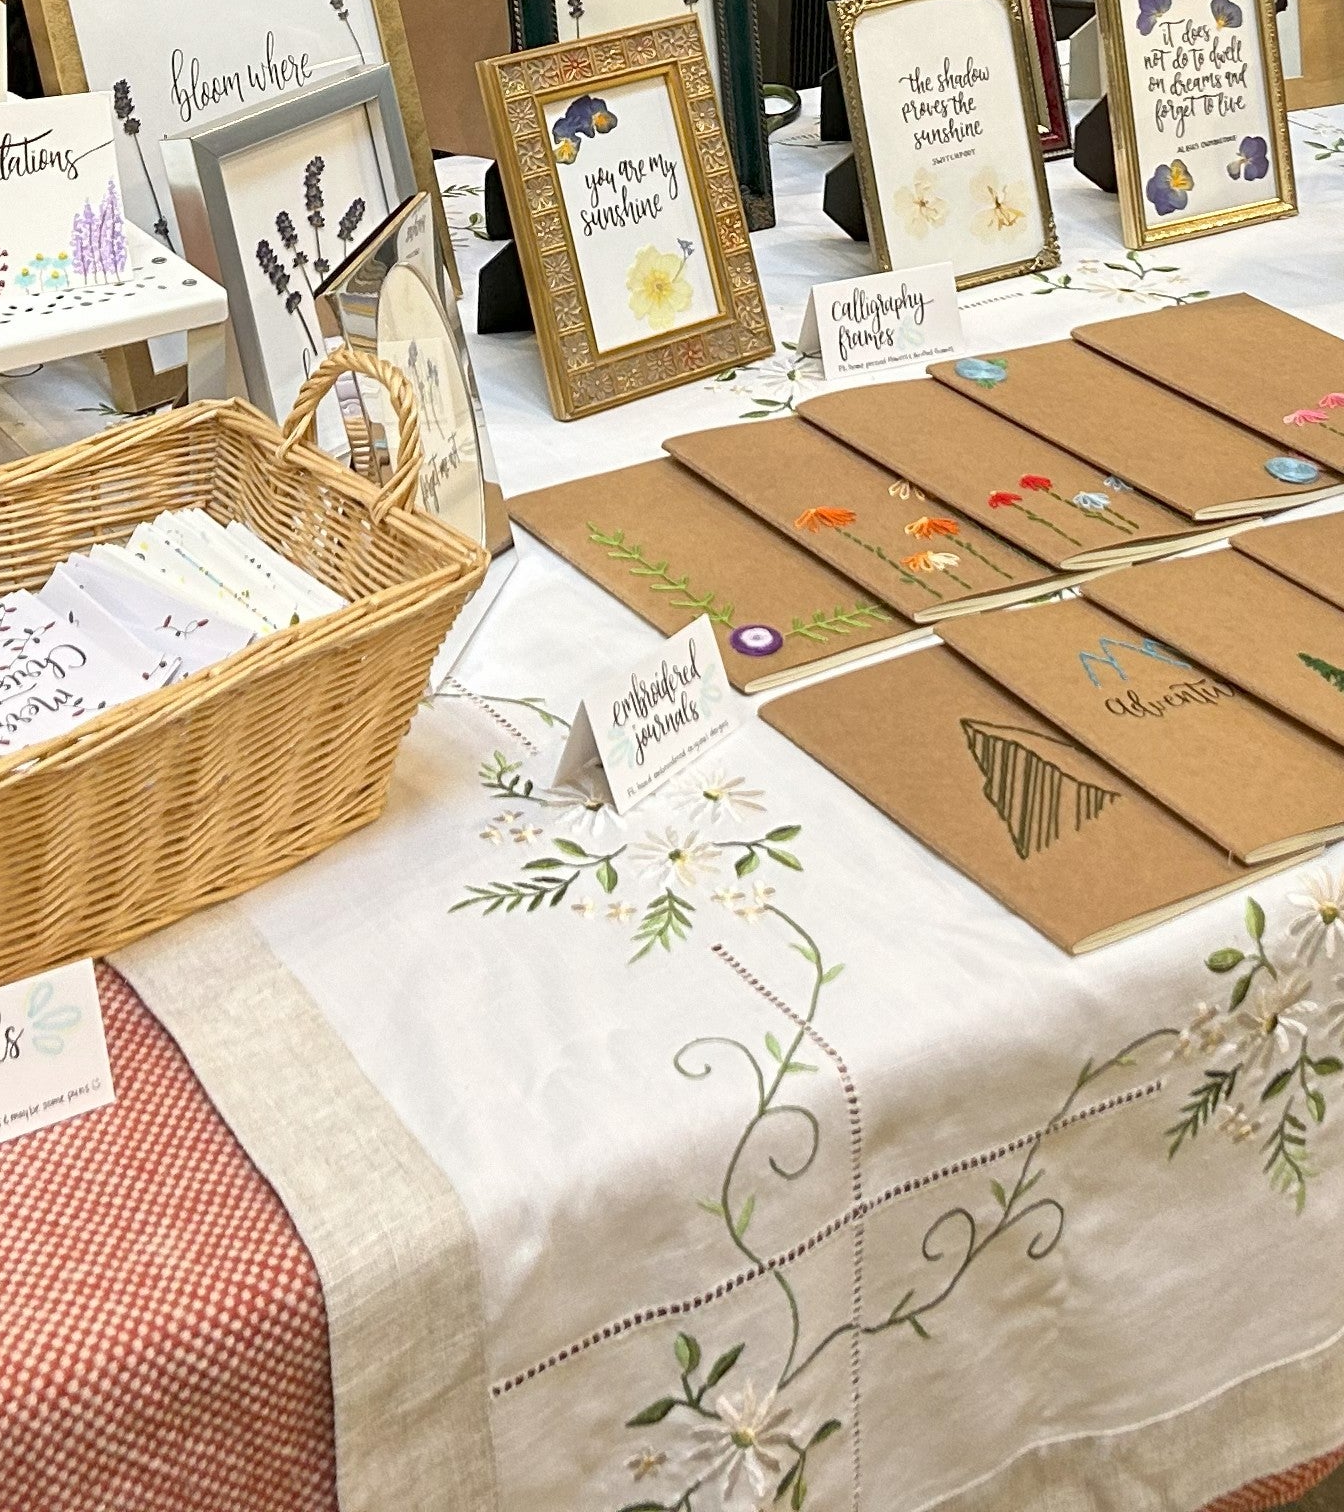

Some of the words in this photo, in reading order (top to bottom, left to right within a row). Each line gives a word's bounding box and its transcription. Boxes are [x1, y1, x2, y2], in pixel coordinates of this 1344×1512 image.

[1159, 19, 1185, 48] it
[1182, 18, 1211, 46] does
[1144, 48, 1172, 71] not
[1172, 46, 1188, 69] do
[1187, 48, 1204, 71] to
[1209, 35, 1243, 69] dwell
[170, 48, 245, 122] bloom
[247, 30, 313, 91] where
[898, 66, 934, 94] the
[937, 56, 990, 93] shadow
[1148, 76, 1166, 94] on
[1169, 71, 1222, 96] dreams
[1224, 62, 1248, 88] and
[901, 99, 948, 124] proves
[947, 91, 977, 116] the
[1155, 95, 1196, 138] forget
[1202, 95, 1215, 115] to
[1218, 92, 1246, 117] live
[913, 117, 984, 150] sunshine
[584, 167, 617, 209] you
[618, 159, 647, 183] are
[648, 153, 678, 200] my
[580, 184, 663, 236] sunshine
[831, 282, 934, 334] calligraphy
[838, 325, 896, 362] frames
[613, 638, 702, 728] embroidered
[631, 691, 700, 766] journals
[10, 1104, 40, 1122] maybe
[42, 1094, 64, 1110] some
[67, 1084, 90, 1102] puns
